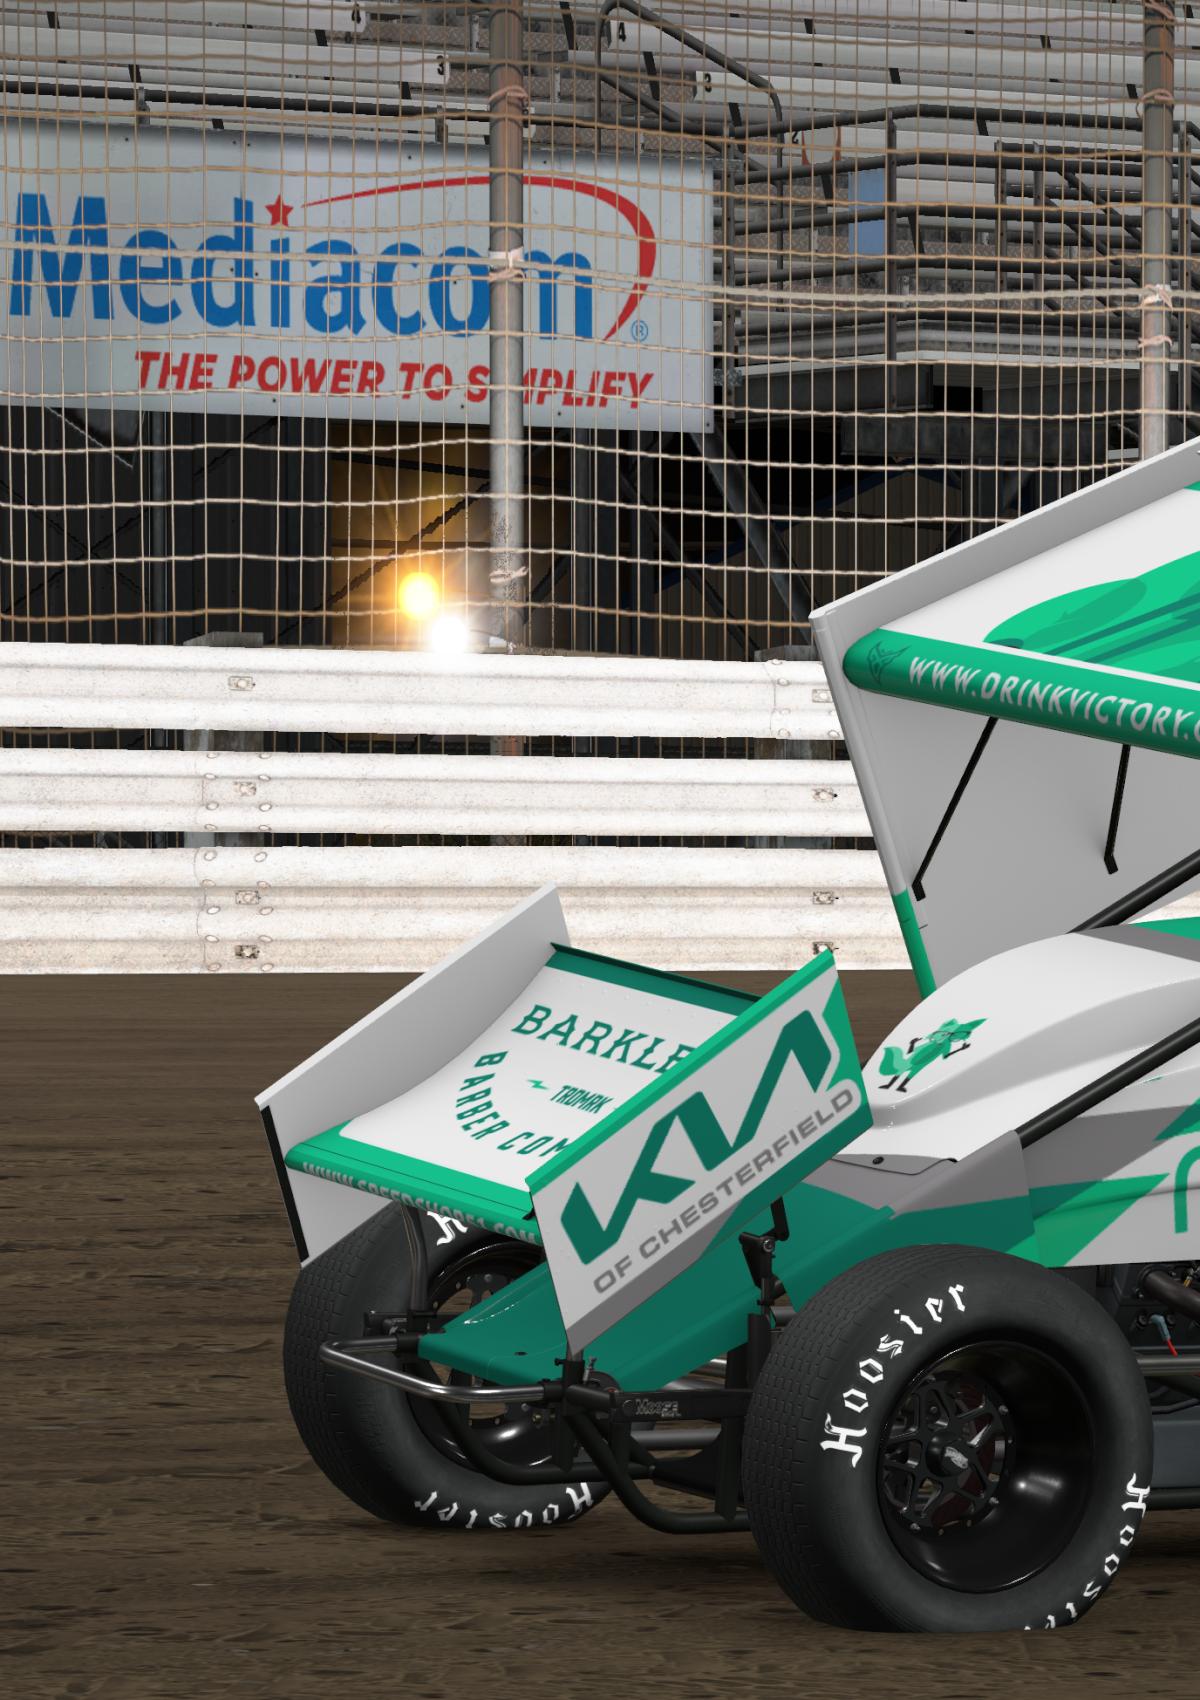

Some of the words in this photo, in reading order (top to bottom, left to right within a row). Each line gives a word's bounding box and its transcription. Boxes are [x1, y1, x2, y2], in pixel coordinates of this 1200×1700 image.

[9, 192, 595, 341] Mediacom
[135, 350, 217, 393] THE
[228, 356, 388, 399] POWER
[399, 361, 455, 402] TO
[456, 1050, 511, 1141] BARBER
[594, 1256, 634, 1295] OF
[640, 1089, 854, 1256] CHESTERFIELD
[820, 1284, 965, 1468] Hoosier
[413, 1481, 594, 1529] Hoosier
[1023, 1472, 1152, 1632] Hoosie
